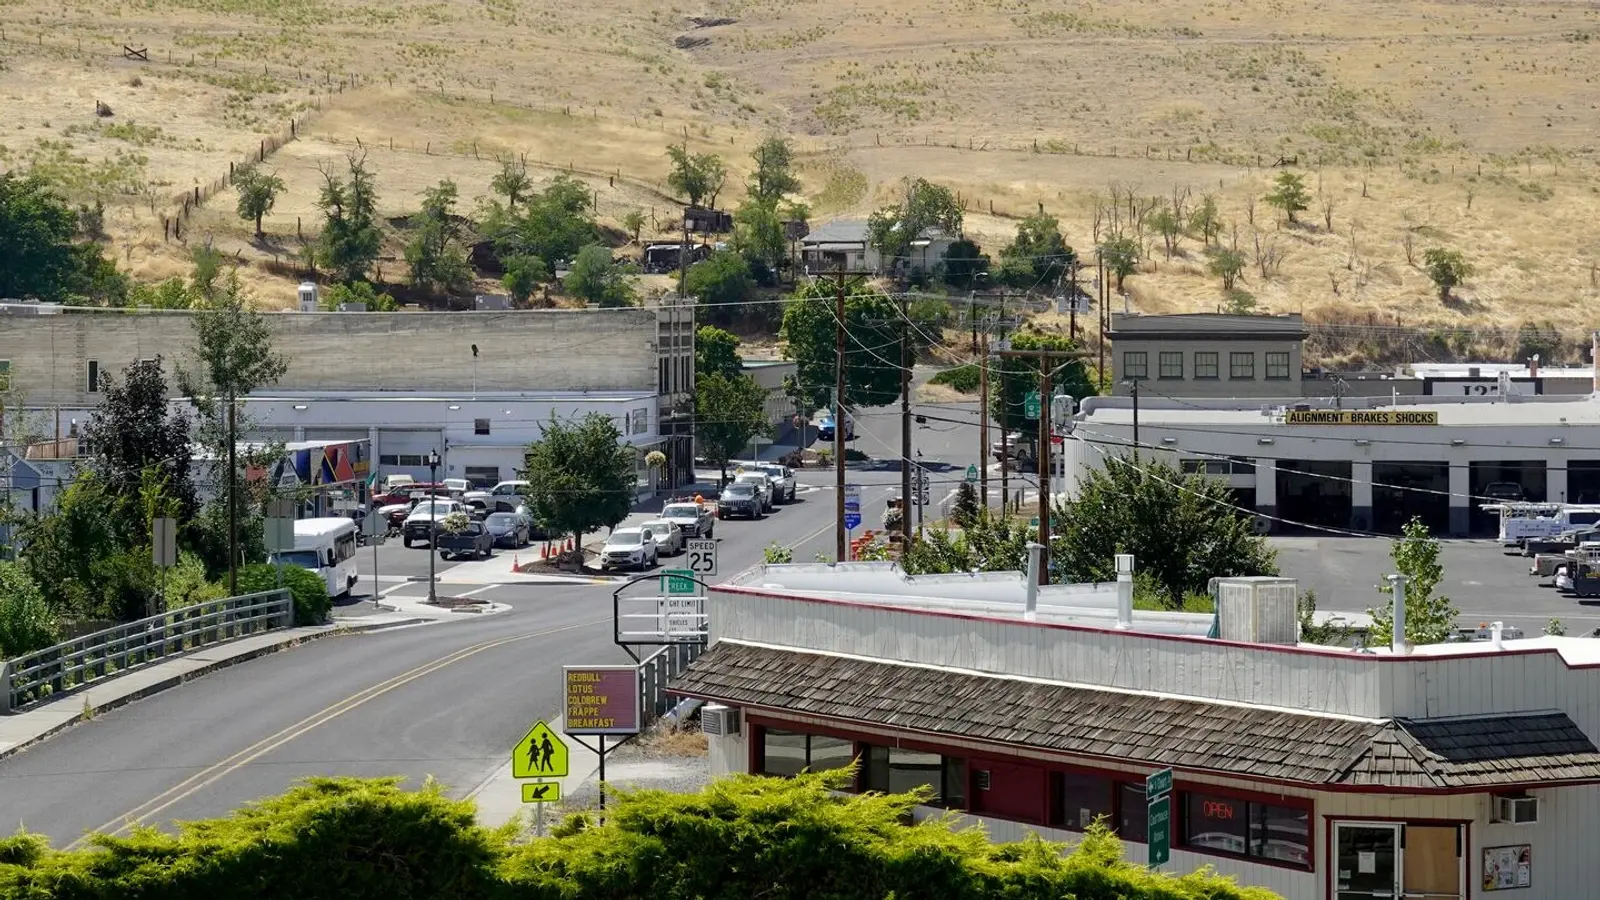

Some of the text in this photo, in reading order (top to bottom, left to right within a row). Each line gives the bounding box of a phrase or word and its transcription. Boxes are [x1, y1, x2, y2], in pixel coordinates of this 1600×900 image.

[1290, 413, 1434, 423] ALIGNMENT BRAKES SHOCKS
[689, 542, 715, 550] SPEED
[690, 552, 713, 571] 25
[668, 583, 688, 591] REEK
[568, 673, 601, 681] REDBULL
[568, 685, 593, 693] LOTUS
[568, 696, 607, 705] COLDBREW
[568, 707, 599, 716] FRAPPE
[568, 718, 615, 727] BREAKFAST
[1204, 801, 1232, 818] OPEN
